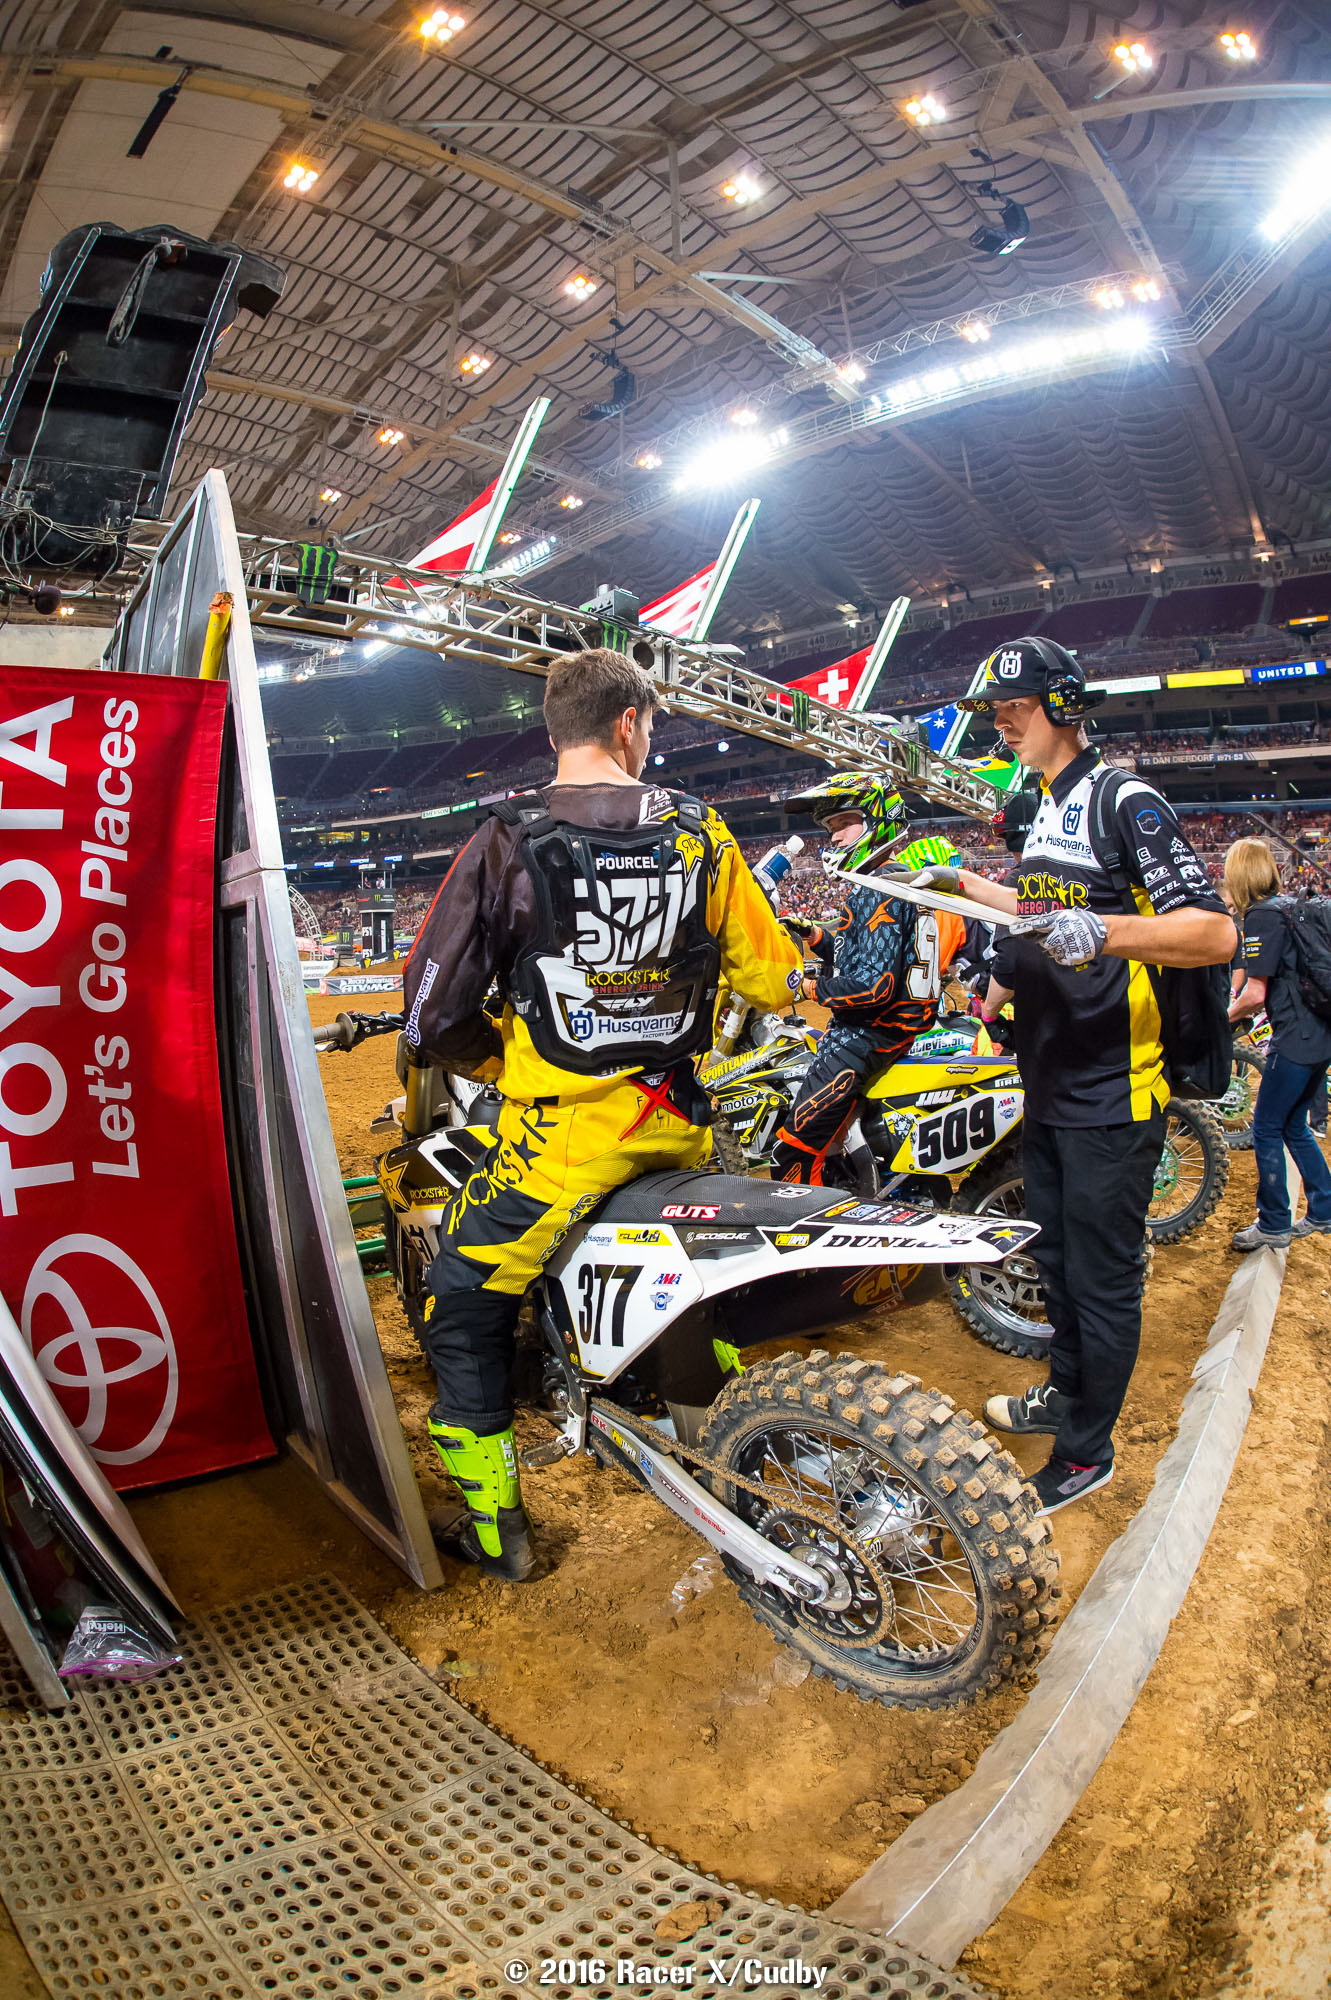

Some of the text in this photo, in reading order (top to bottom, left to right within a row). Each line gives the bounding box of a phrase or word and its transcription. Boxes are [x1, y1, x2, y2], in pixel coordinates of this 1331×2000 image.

[1257, 666, 1304, 679] UNITED
[1152, 756, 1170, 765] DAN
[1172, 753, 1215, 764] DIERDORF
[422, 808, 449, 818] EMERSON
[1045, 834, 1092, 855] Husqvarna
[595, 856, 659, 870] POURCEL
[1149, 880, 1181, 902] EXCEL
[573, 874, 686, 962] 377
[79, 697, 140, 1179] Let's Go Places
[410, 963, 435, 1026] Husqvarna
[593, 983, 664, 995] ENERGY DRINK
[597, 996, 656, 1009] FLY
[598, 1014, 683, 1036] Husqvarna
[700, 1050, 754, 1085] SPORTLAND
[722, 1095, 755, 1112] moto
[997, 1096, 1016, 1109] AMA
[918, 1096, 997, 1169] 509
[662, 1204, 721, 1219] GUTS
[693, 1231, 751, 1241] SCOSCHE
[822, 1234, 973, 1249] DUNLOP
[652, 1272, 683, 1285] AMA
[578, 1263, 645, 1348] 377
[592, 1413, 607, 1432] RK
[701, 1512, 726, 1536] brembo
[89, 1620, 125, 1634] Hefty
